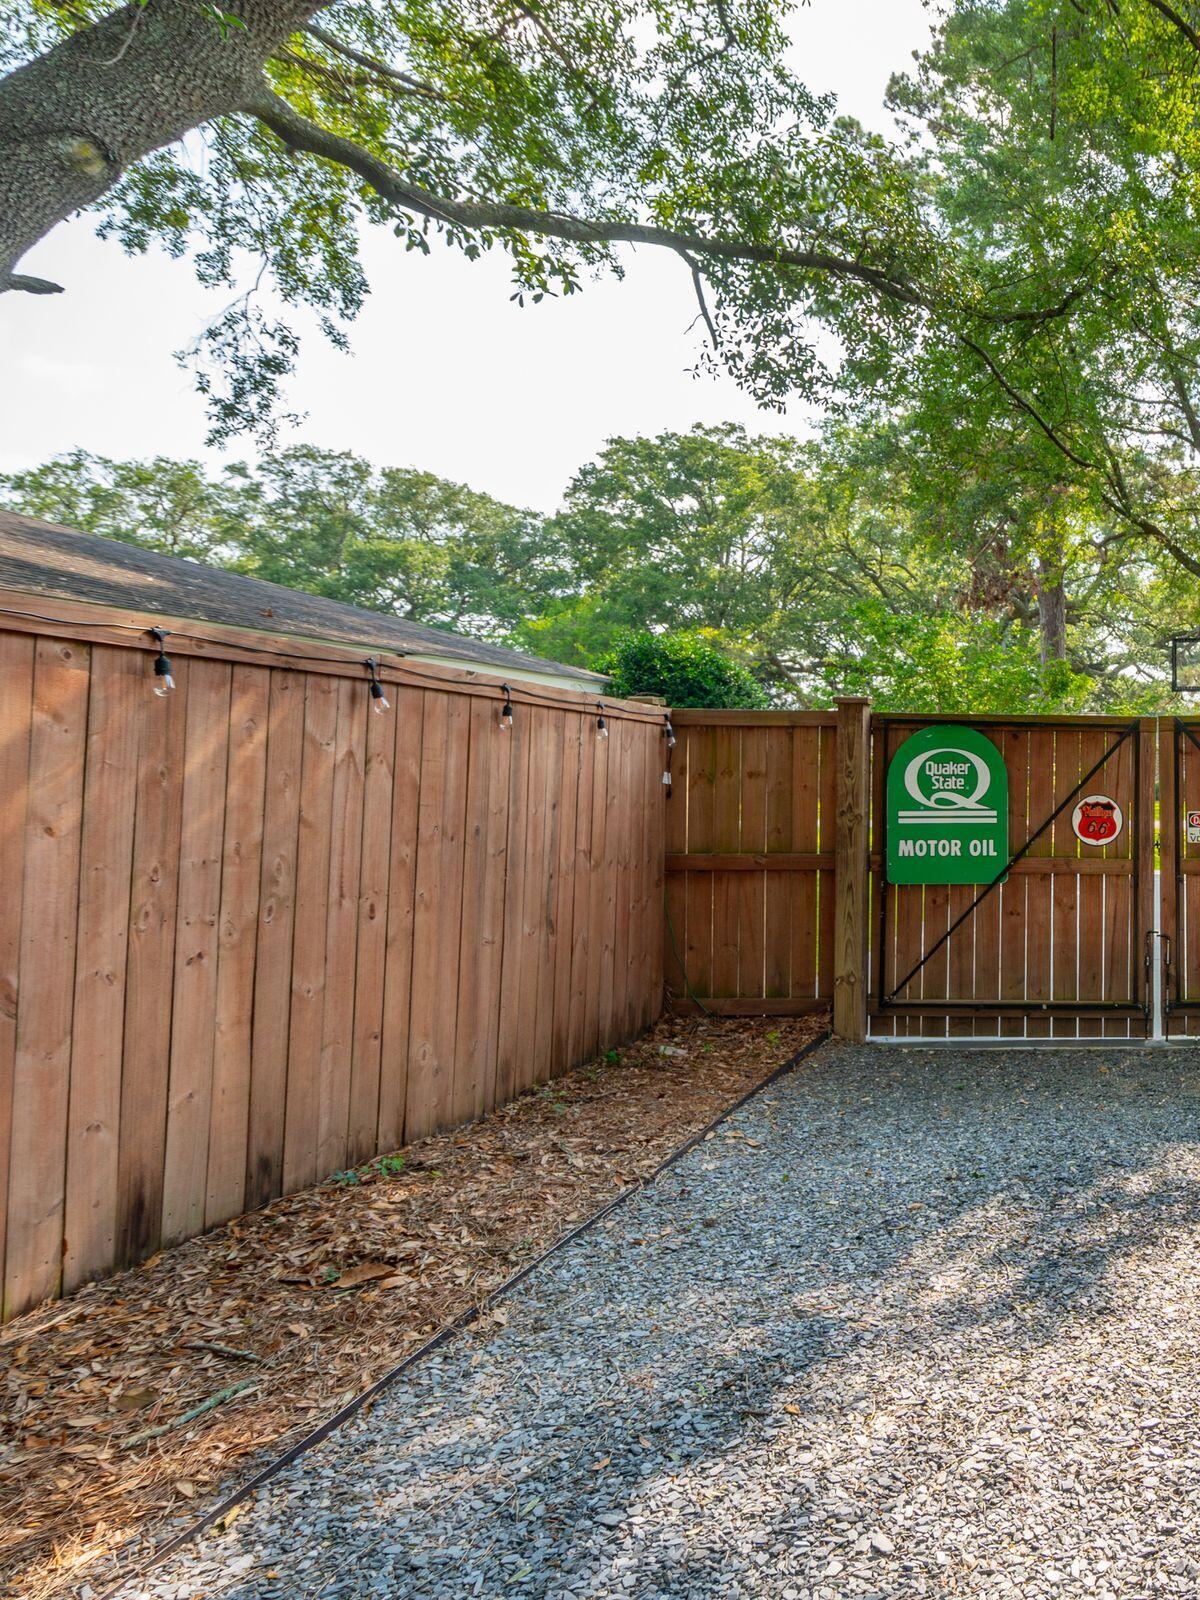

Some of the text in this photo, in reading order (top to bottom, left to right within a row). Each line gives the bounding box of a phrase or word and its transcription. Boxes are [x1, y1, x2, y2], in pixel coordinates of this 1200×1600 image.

[925, 761, 971, 776] Quaker
[931, 776, 965, 789] State
[1088, 820, 1108, 834] 66
[898, 839, 997, 857] MOTOR OIL
